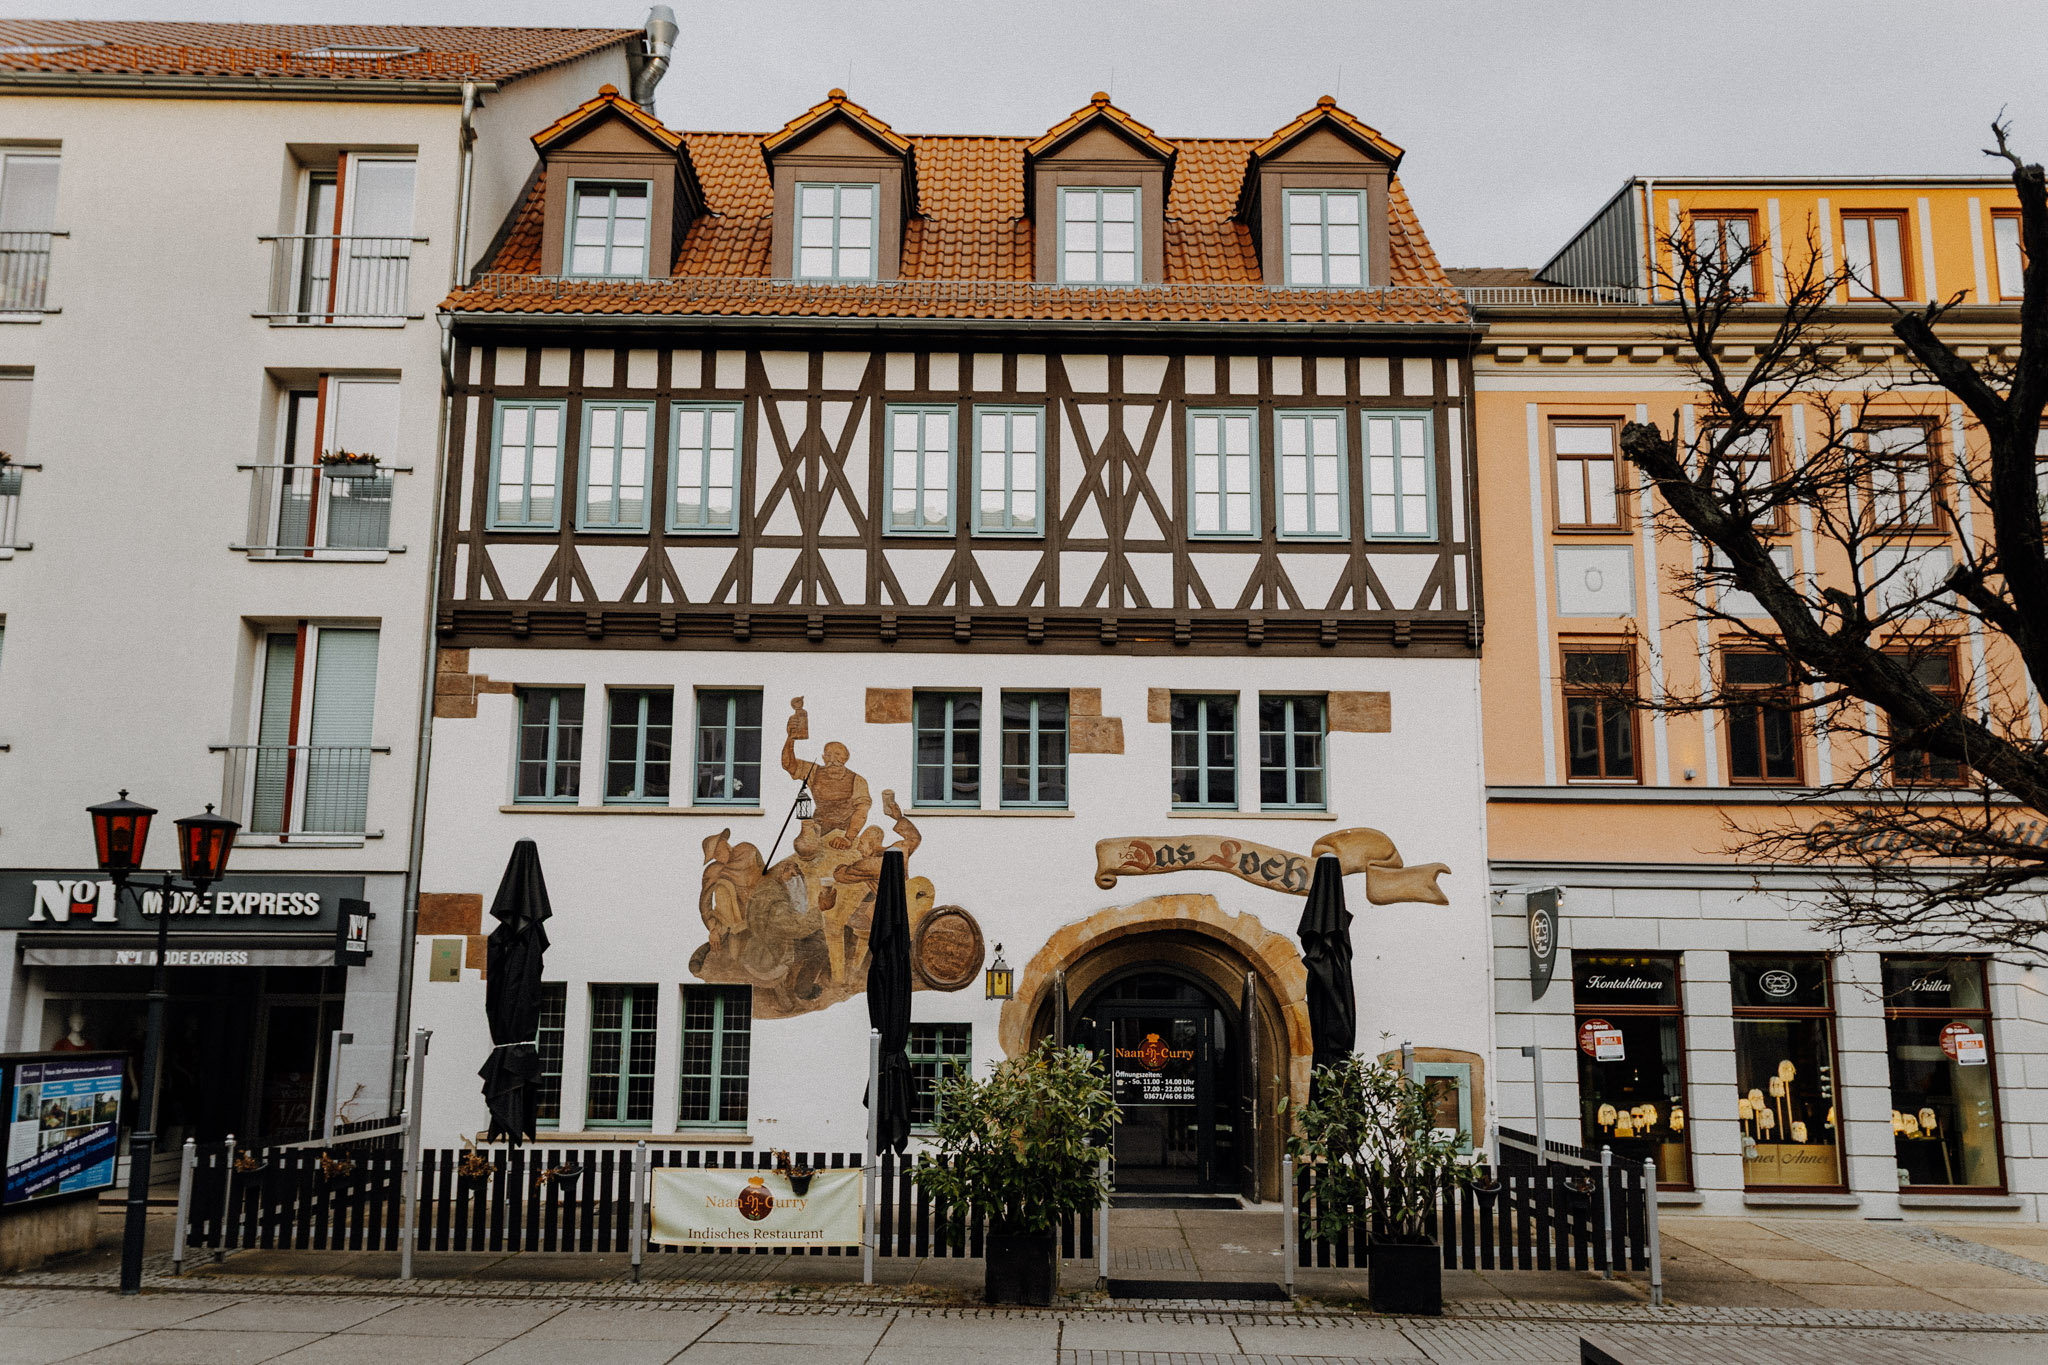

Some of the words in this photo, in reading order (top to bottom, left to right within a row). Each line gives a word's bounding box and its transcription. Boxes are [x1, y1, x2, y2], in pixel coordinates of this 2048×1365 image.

[215, 892, 320, 915] EXPRESS
[190, 952, 248, 965] EXPRESS
[1585, 975, 1663, 989] Kontaktlinsen
[1909, 978, 1952, 992] Brillen
[1115, 1070, 1163, 1079] Öffnungszeiten:
[688, 1228, 750, 1239] Indisches
[753, 1228, 824, 1239] Restaurant
